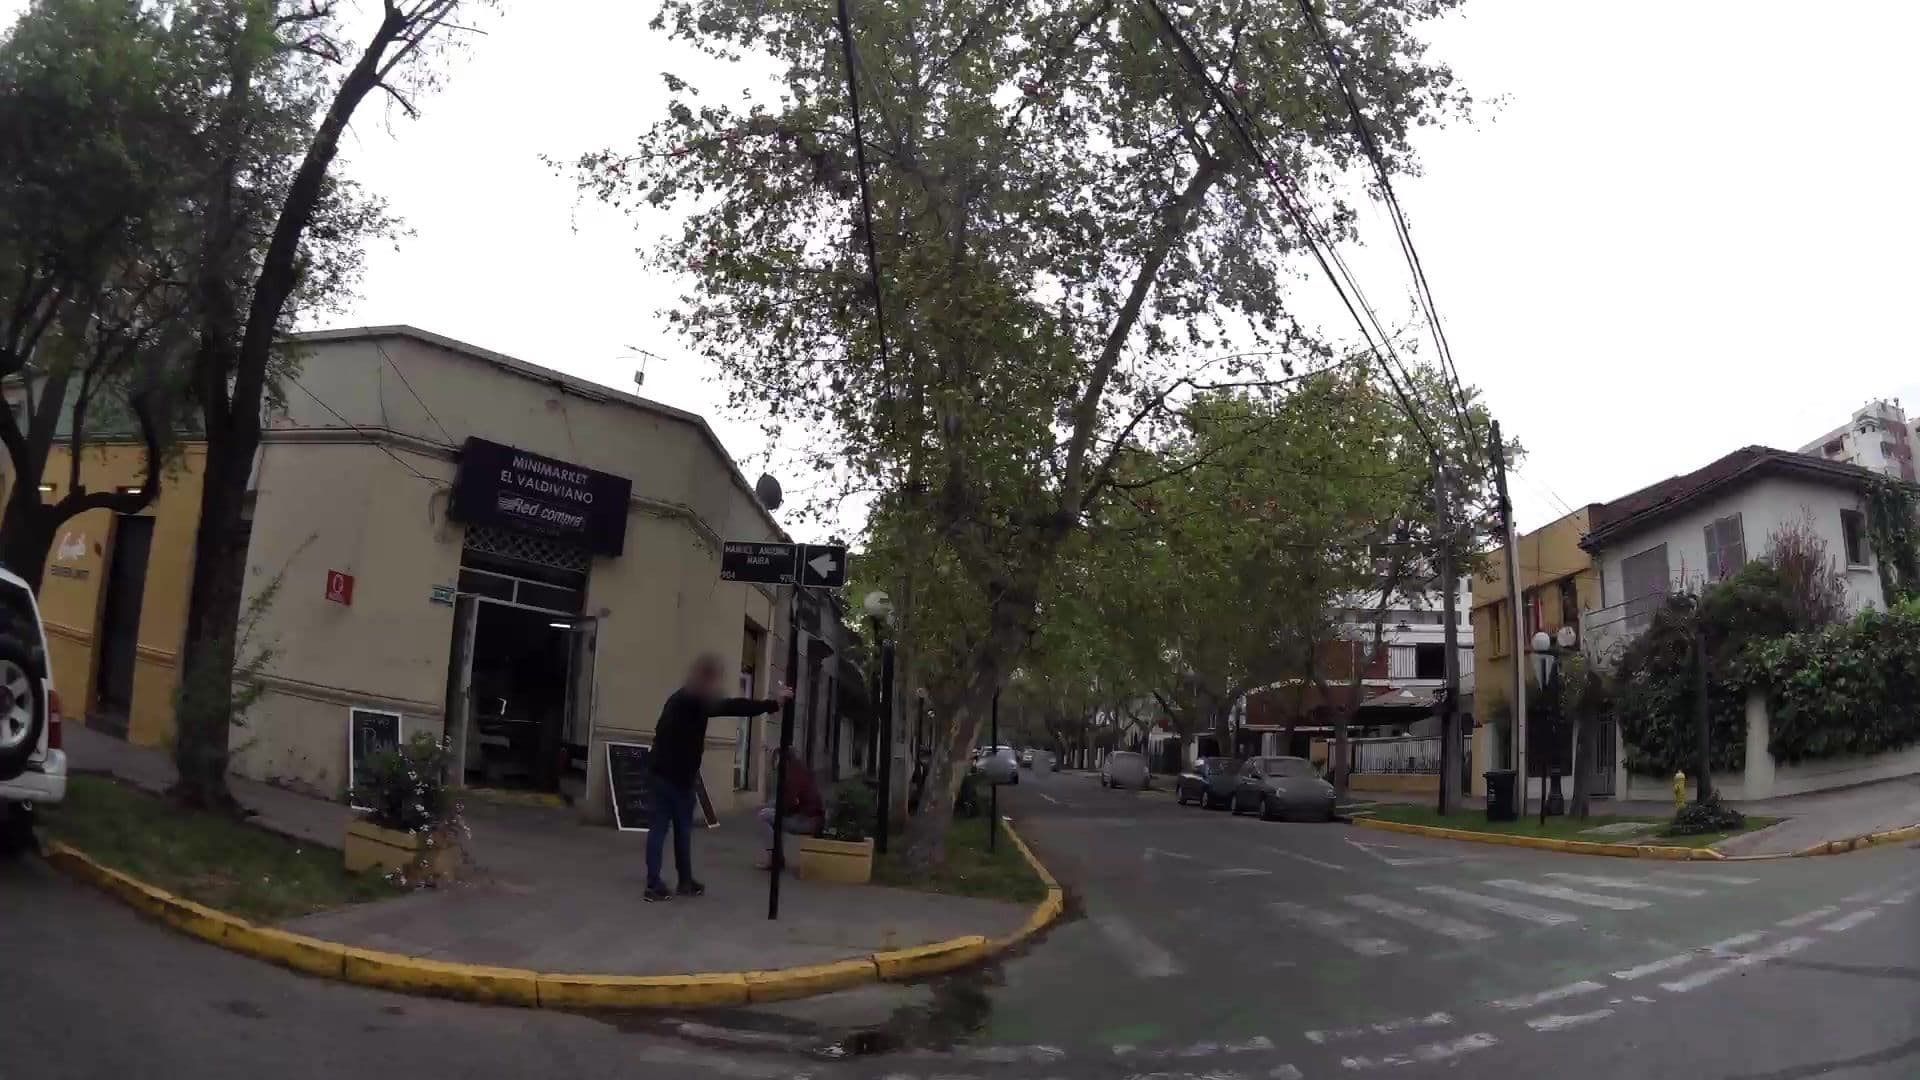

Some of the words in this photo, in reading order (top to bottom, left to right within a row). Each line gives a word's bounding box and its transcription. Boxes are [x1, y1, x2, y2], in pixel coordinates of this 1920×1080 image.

[512, 455, 588, 486] MINIMARKET
[500, 470, 513, 484] EL
[517, 474, 594, 504] VALDIVIANO
